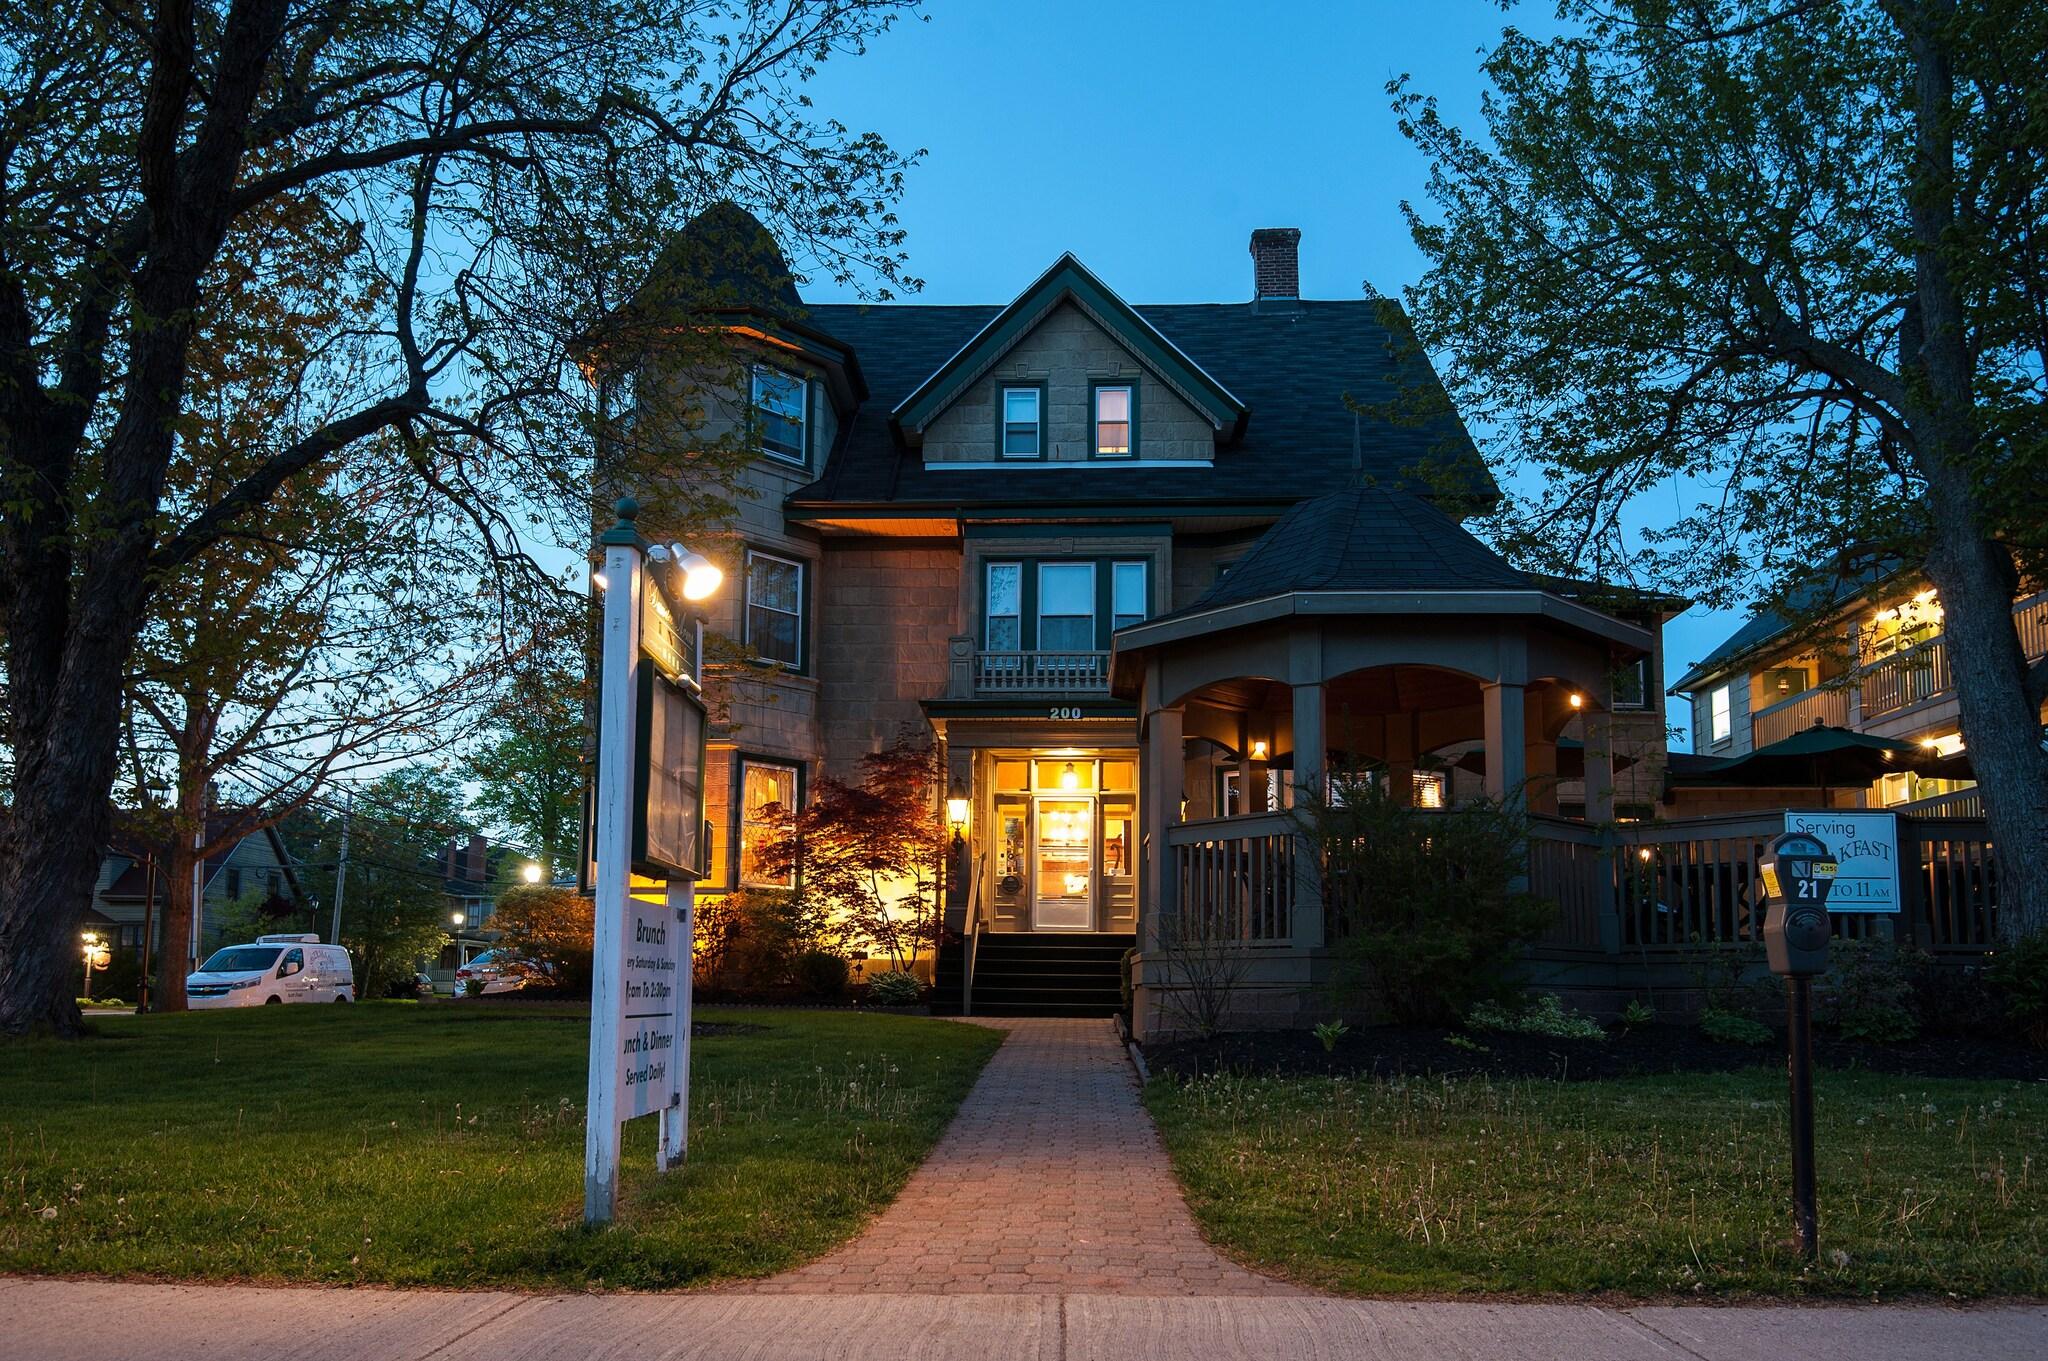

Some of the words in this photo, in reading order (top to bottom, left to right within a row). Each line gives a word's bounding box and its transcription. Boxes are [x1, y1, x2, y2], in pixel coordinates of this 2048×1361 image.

[1050, 707, 1081, 719] 200
[1796, 818, 1856, 838] Serving
[1831, 840, 1891, 863] KFAST
[1798, 880, 1817, 898] 21
[1832, 884, 1853, 897] TO
[1856, 882, 1870, 897] 11
[1872, 888, 1890, 897] AM
[636, 917, 666, 945] Brunch
[626, 957, 635, 972] ery
[635, 955, 657, 973] Saturday
[660, 958, 676, 974] Sunday
[642, 981, 650, 998] To
[650, 981, 671, 1001] 2:30pm
[624, 1031, 641, 1054] nch
[643, 1031, 648, 1051] &
[650, 1030, 673, 1051] Dinner
[626, 1063, 648, 1086] Served
[649, 1061, 666, 1083] Daily!
